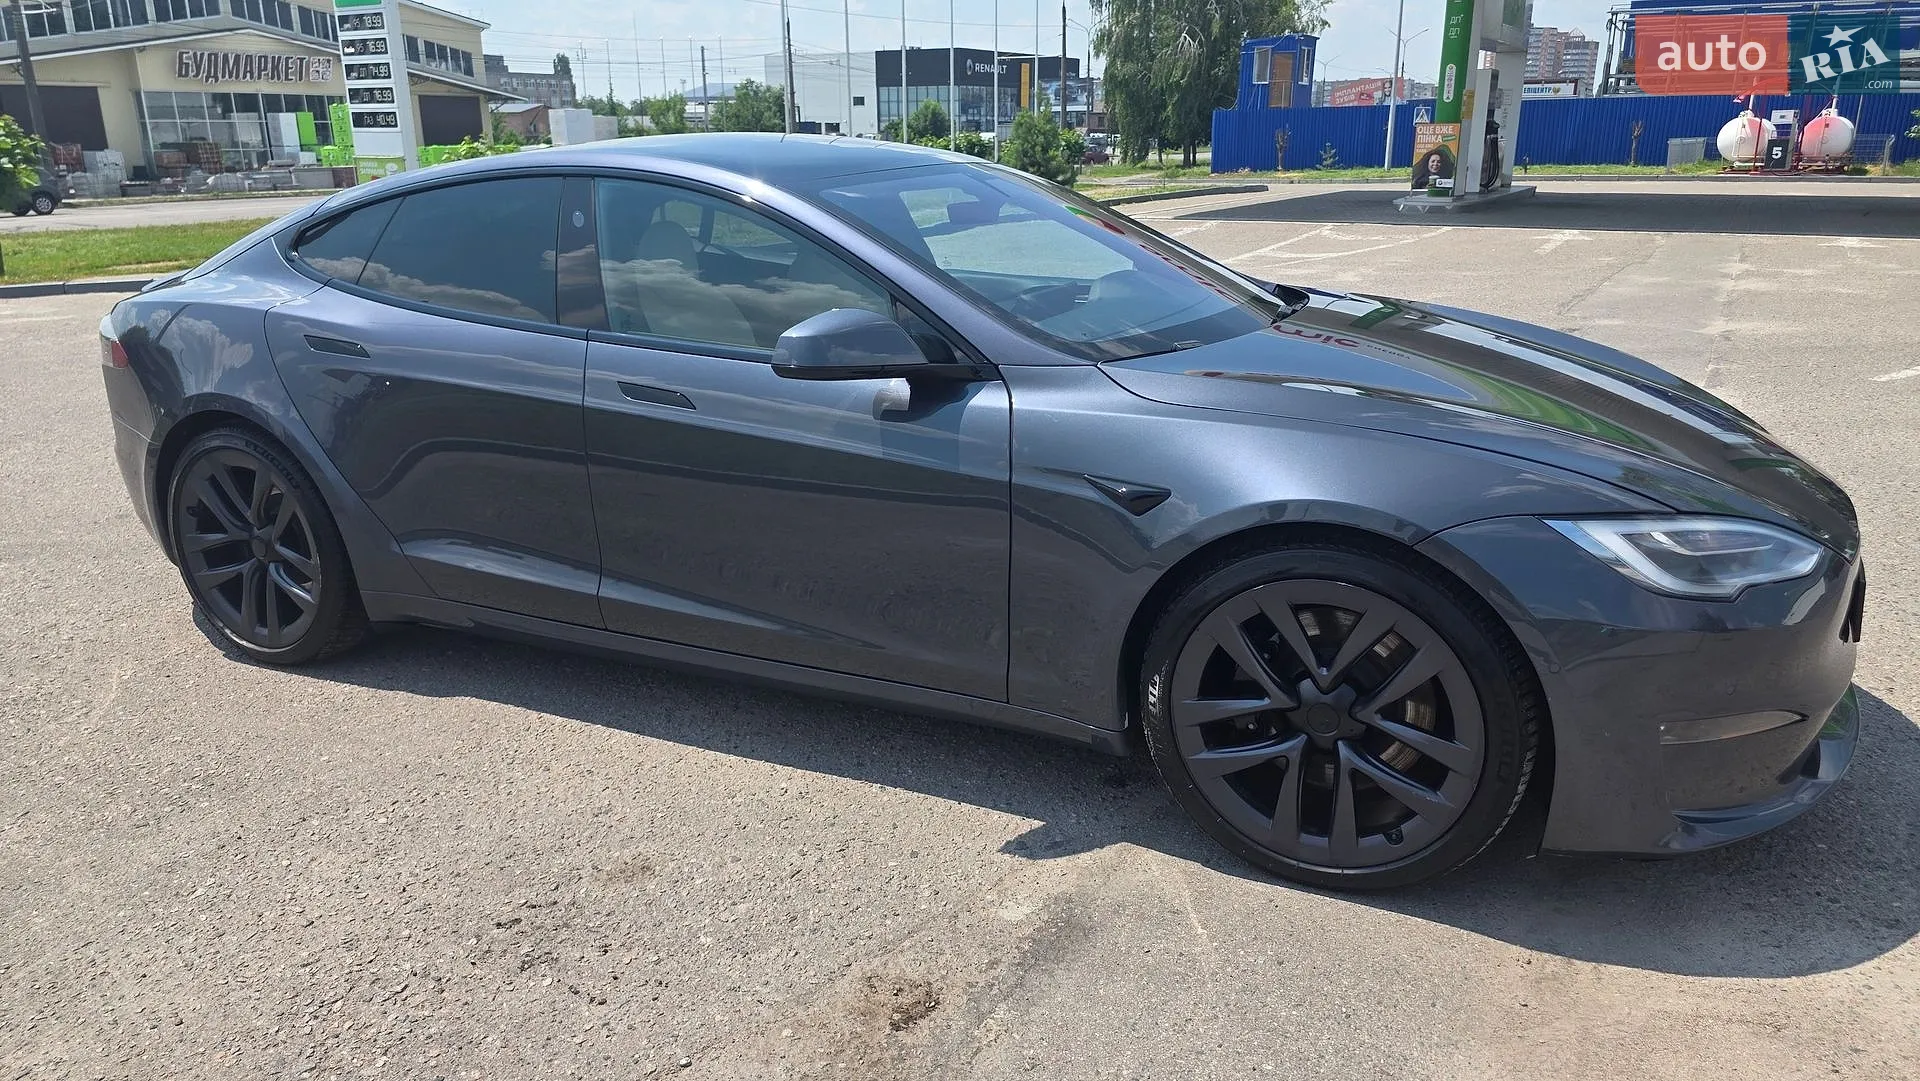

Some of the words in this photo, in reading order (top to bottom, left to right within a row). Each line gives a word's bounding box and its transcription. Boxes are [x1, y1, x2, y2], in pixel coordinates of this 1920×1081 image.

[176, 50, 307, 83] БУДМАРКЕТ
[975, 63, 1008, 75] RENAULT
[1417, 125, 1435, 135] ОЦЕ
[1435, 125, 1454, 134] ВЖЕ
[1416, 134, 1443, 143] ПІНКА
[1771, 146, 1783, 159] 5
